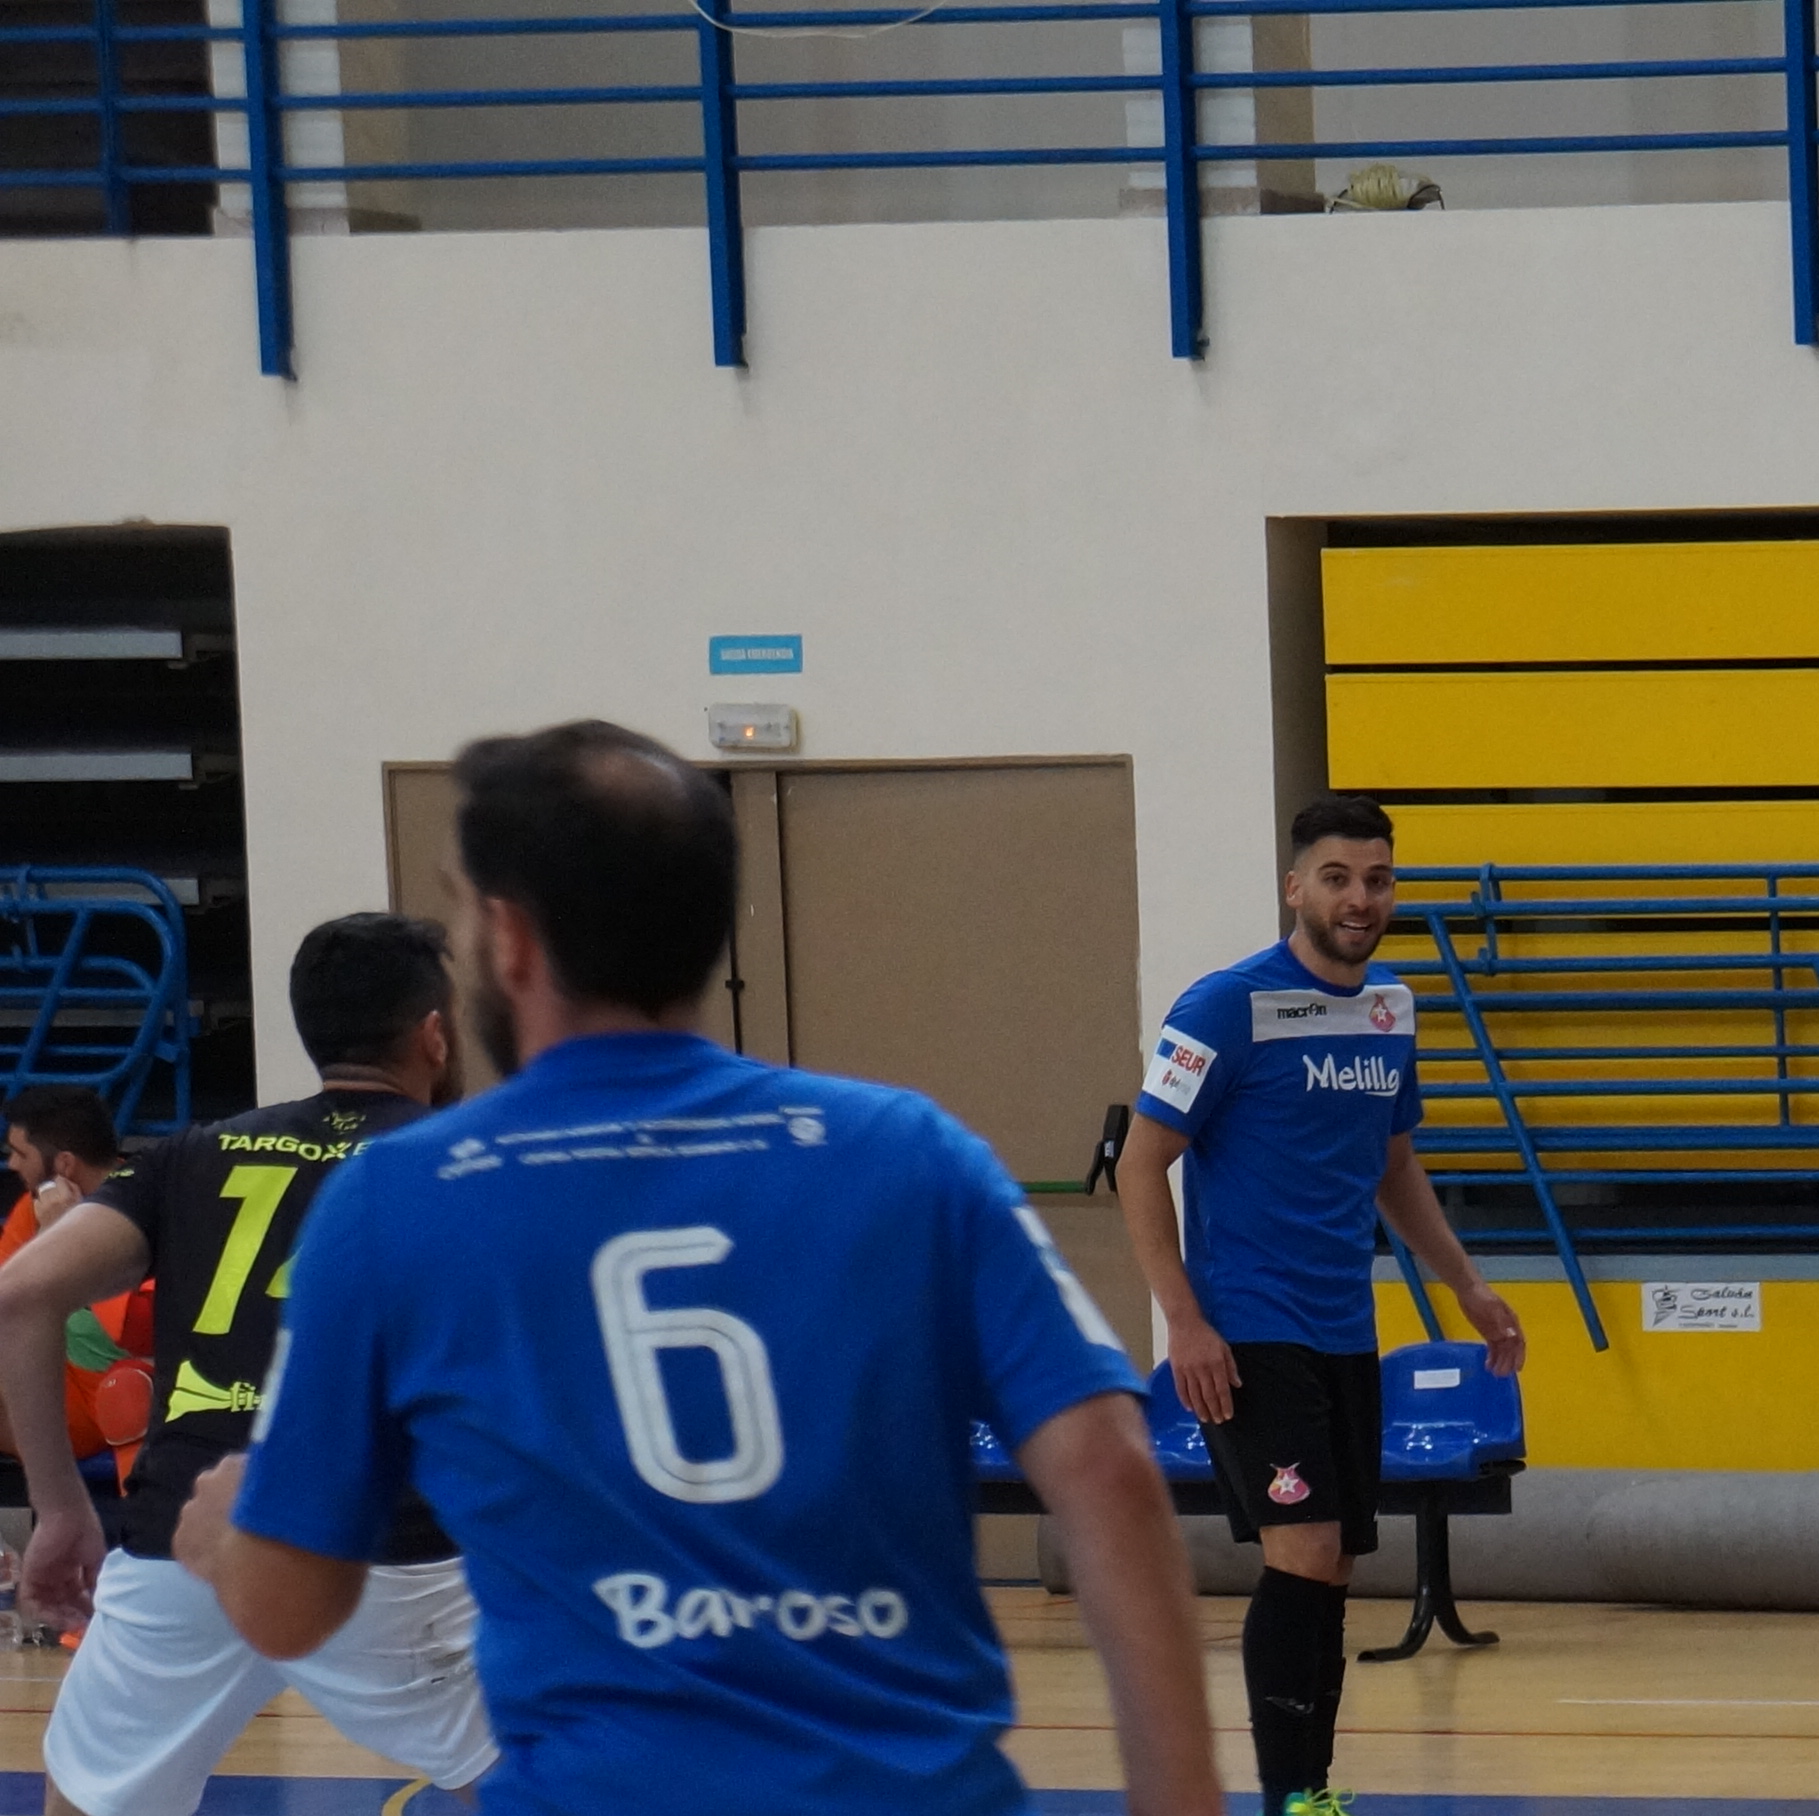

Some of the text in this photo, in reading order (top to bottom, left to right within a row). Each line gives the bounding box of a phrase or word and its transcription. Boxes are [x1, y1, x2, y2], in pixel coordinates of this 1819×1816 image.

[1171, 1045, 1206, 1077] SEUR
[1302, 1052, 1400, 1096] Melilla
[591, 1226, 785, 1503] 6
